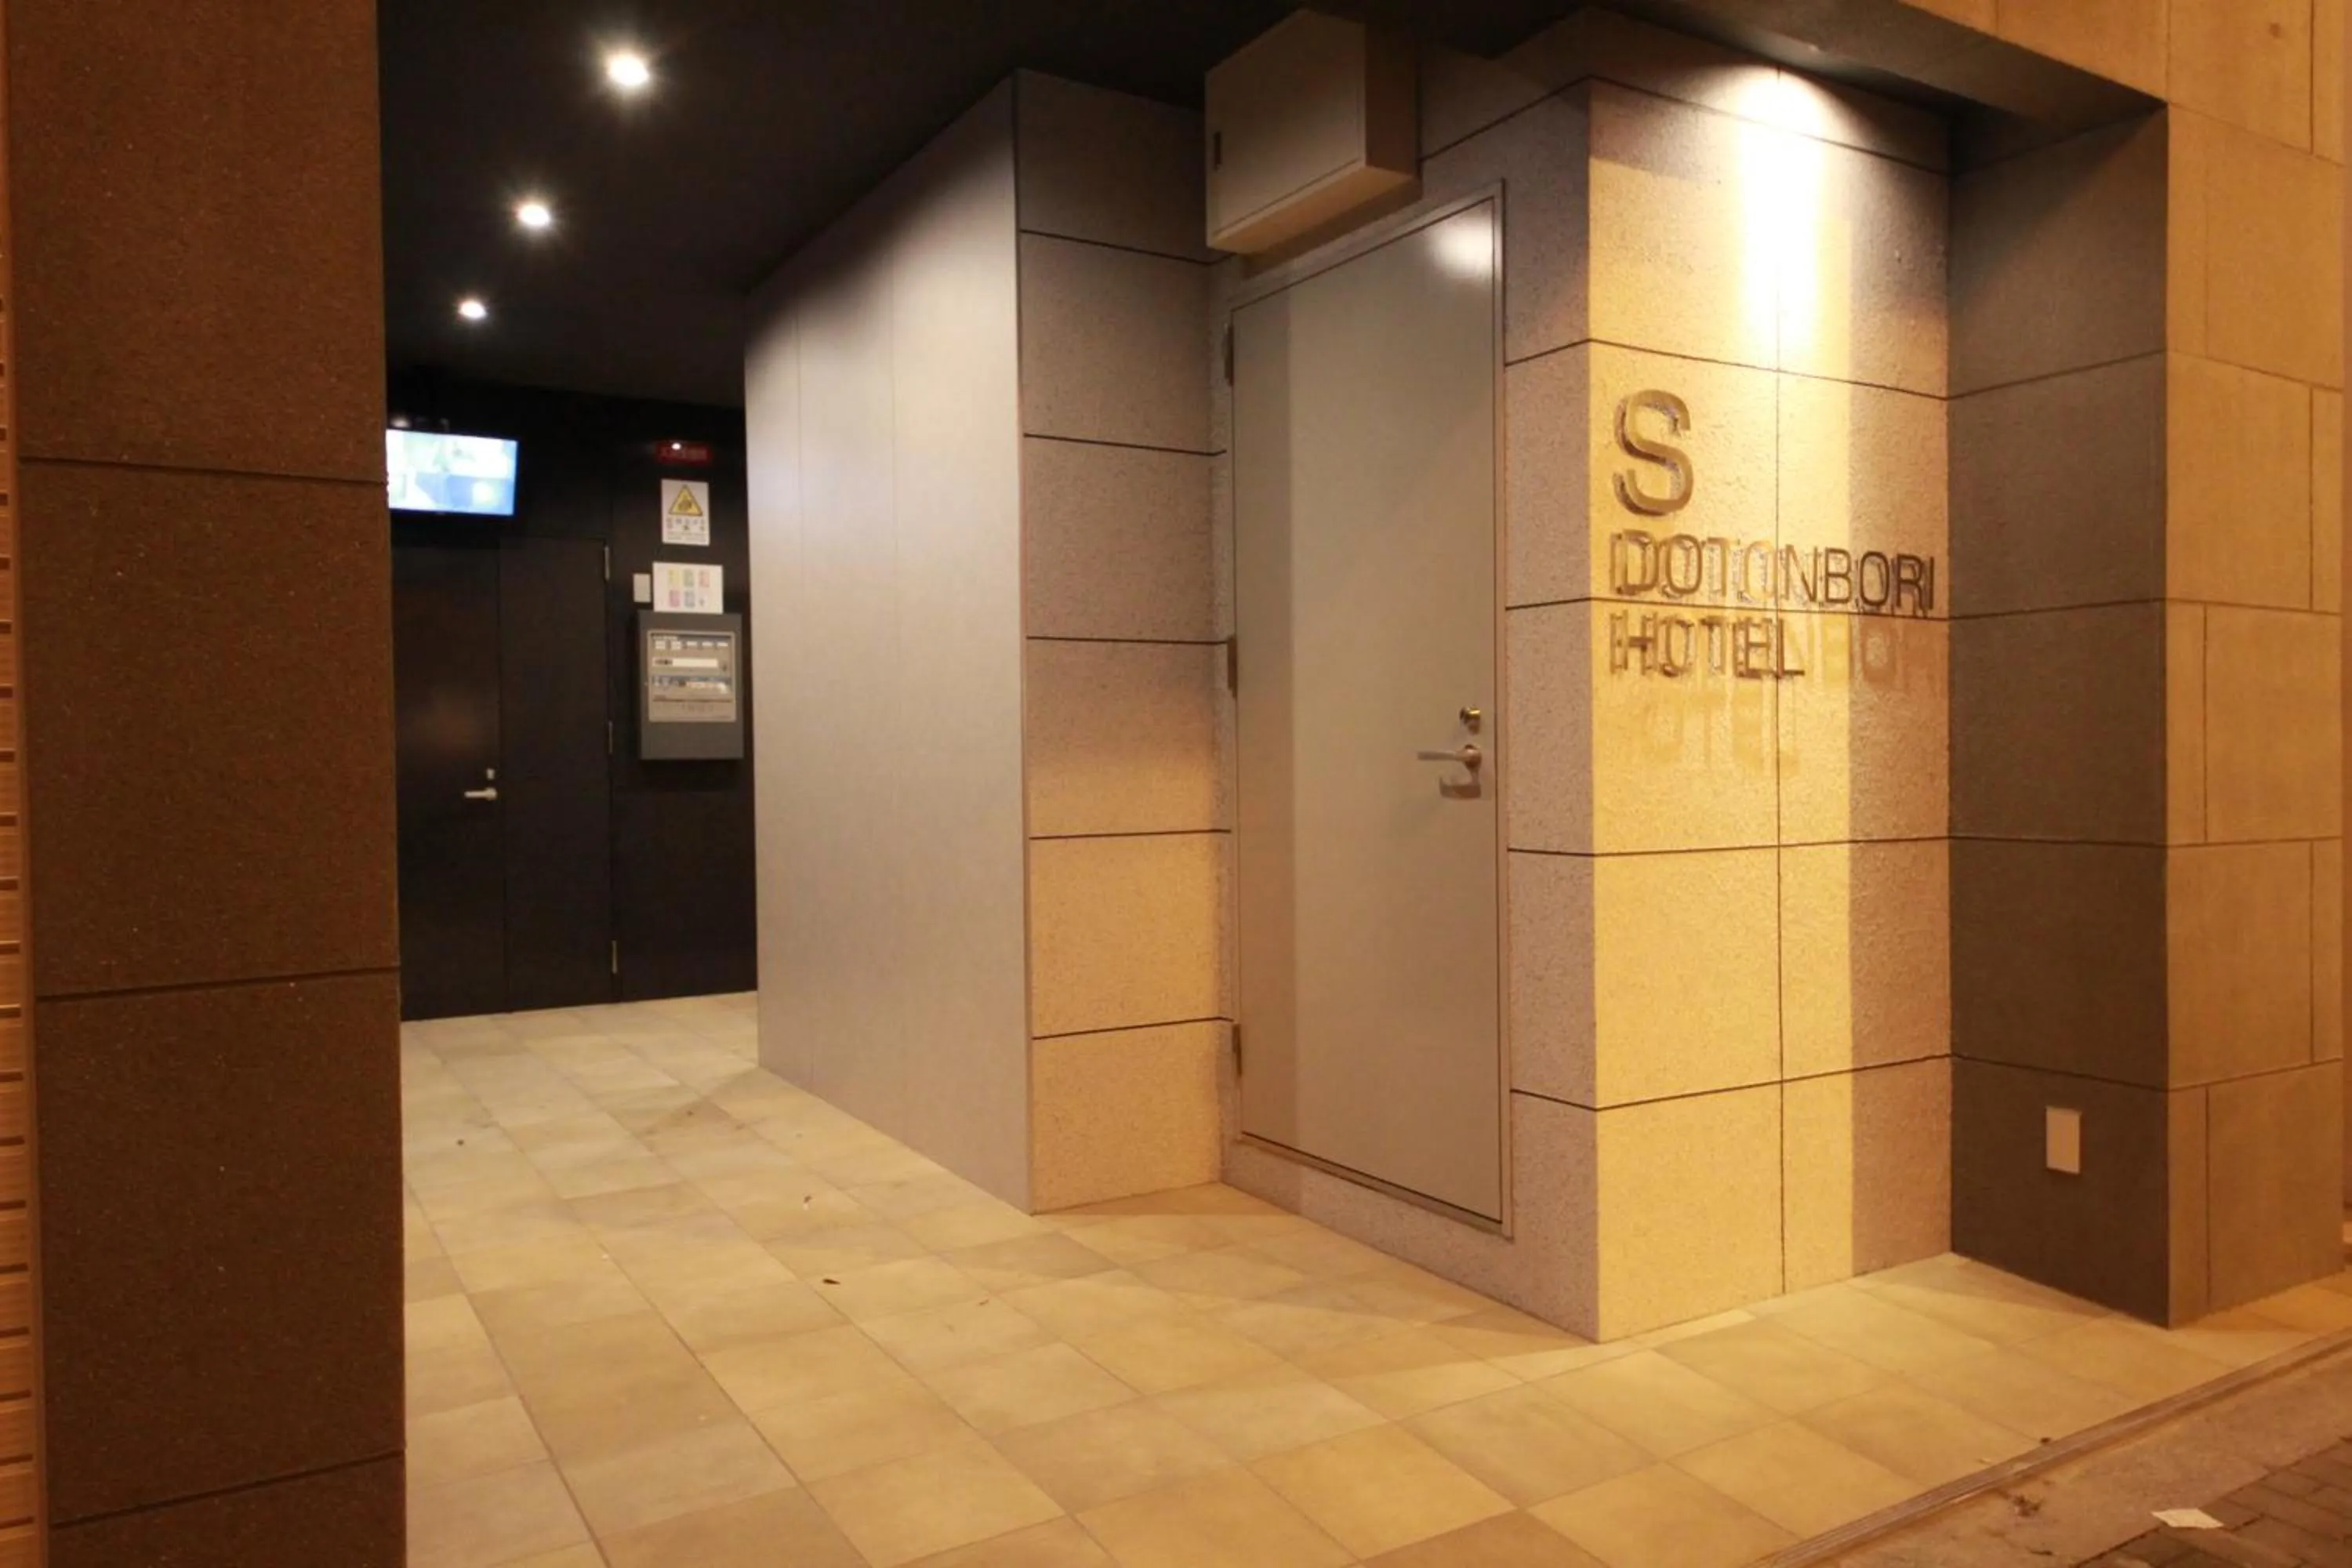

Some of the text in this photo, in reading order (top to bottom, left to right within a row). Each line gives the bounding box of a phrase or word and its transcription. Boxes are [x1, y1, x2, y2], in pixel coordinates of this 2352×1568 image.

[1613, 389, 1694, 516] S
[1610, 529, 1935, 611] DOTONBORI
[1610, 611, 1806, 679] HOTEL
